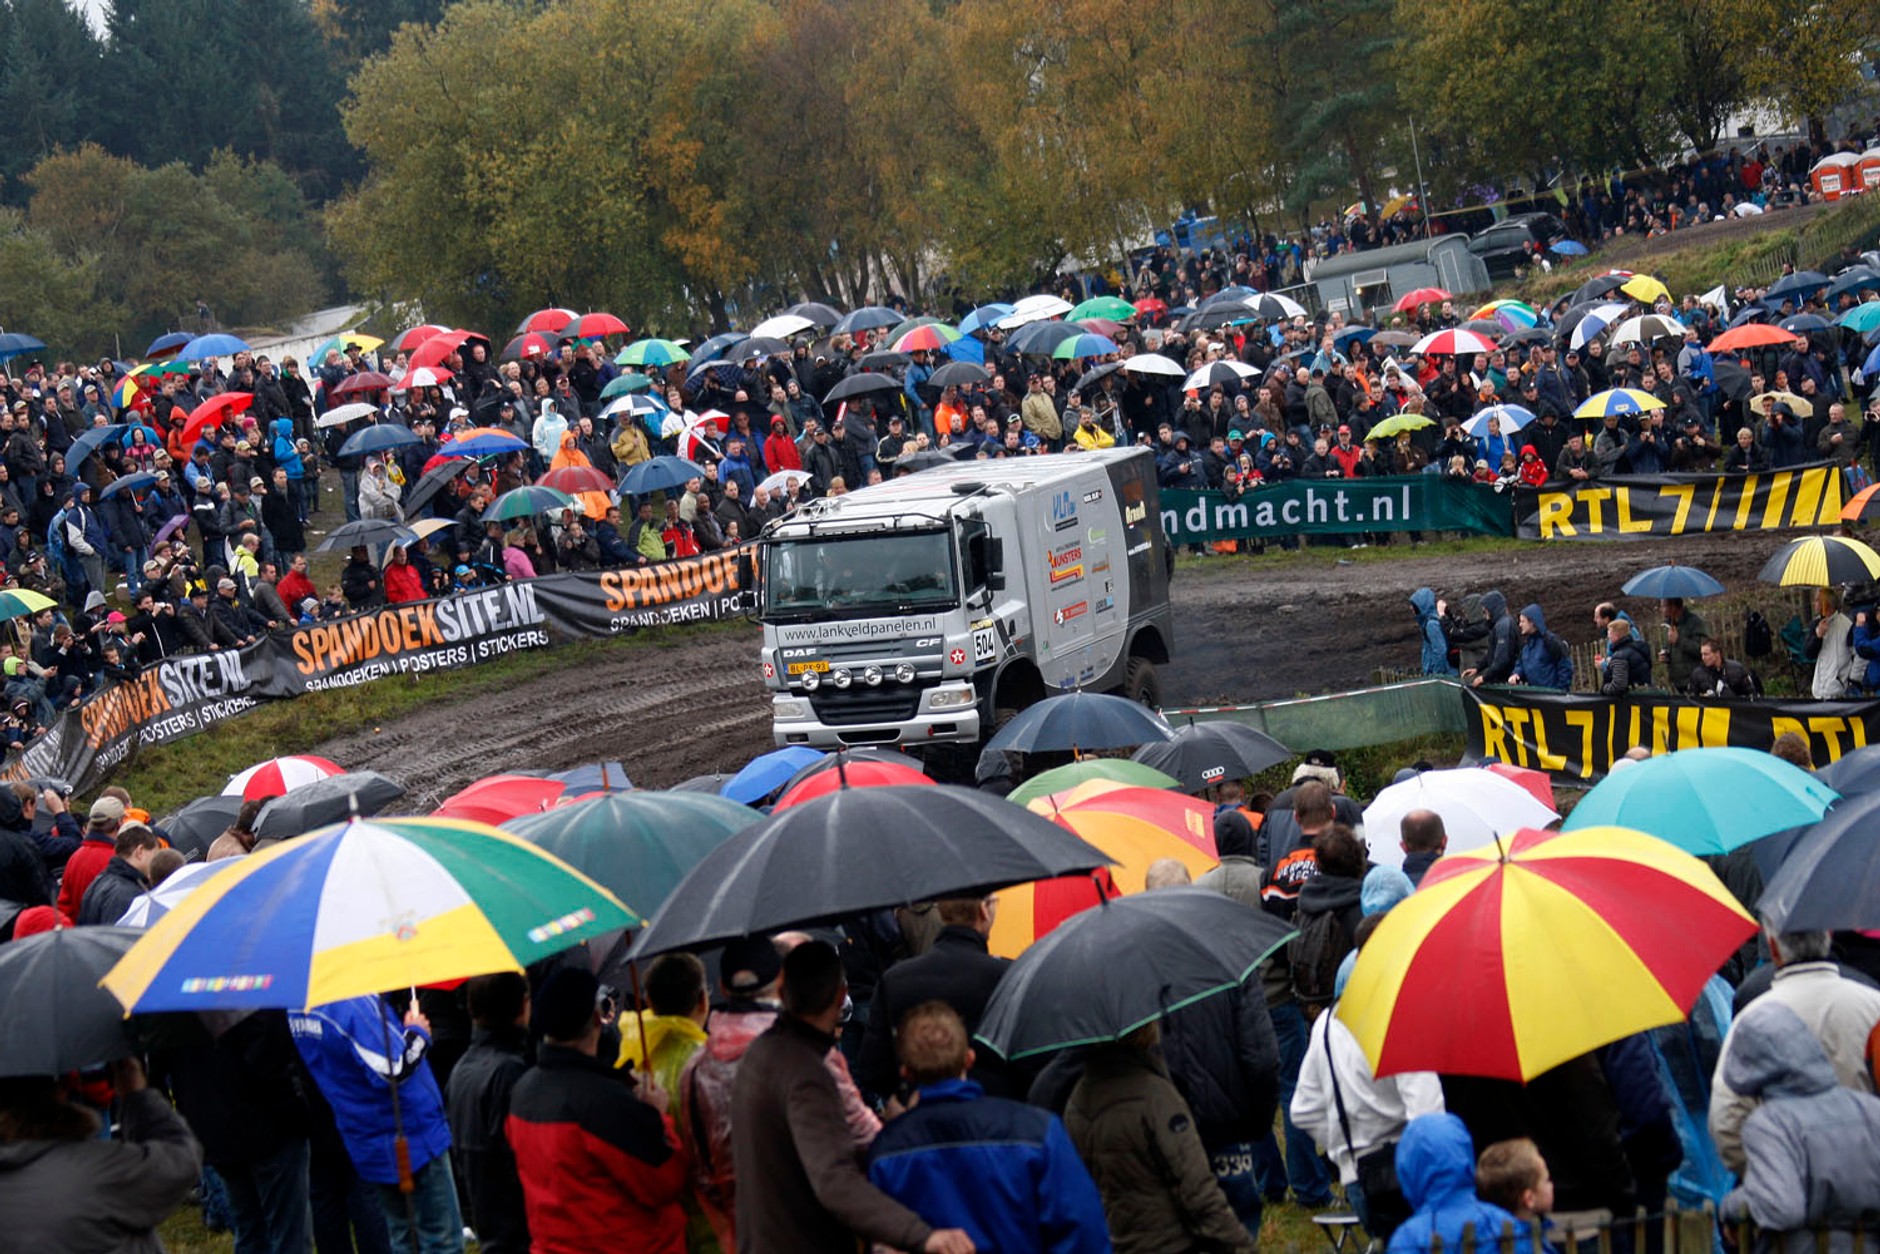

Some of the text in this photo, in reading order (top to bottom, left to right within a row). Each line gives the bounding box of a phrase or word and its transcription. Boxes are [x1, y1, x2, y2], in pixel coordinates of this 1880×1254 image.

[1538, 484, 1695, 539] RTL 7
[292, 582, 545, 675] SPANDOEKSITE.NL
[610, 602, 711, 632] SPANDOEKEN
[784, 617, 936, 641] www.lankveldpanelen.nl
[400, 647, 468, 674] POSTERS
[478, 629, 549, 657] STICKERS
[783, 648, 817, 658] DAF
[915, 638, 942, 648] CF
[975, 631, 994, 657] 504
[1480, 704, 1593, 778] RTL 7
